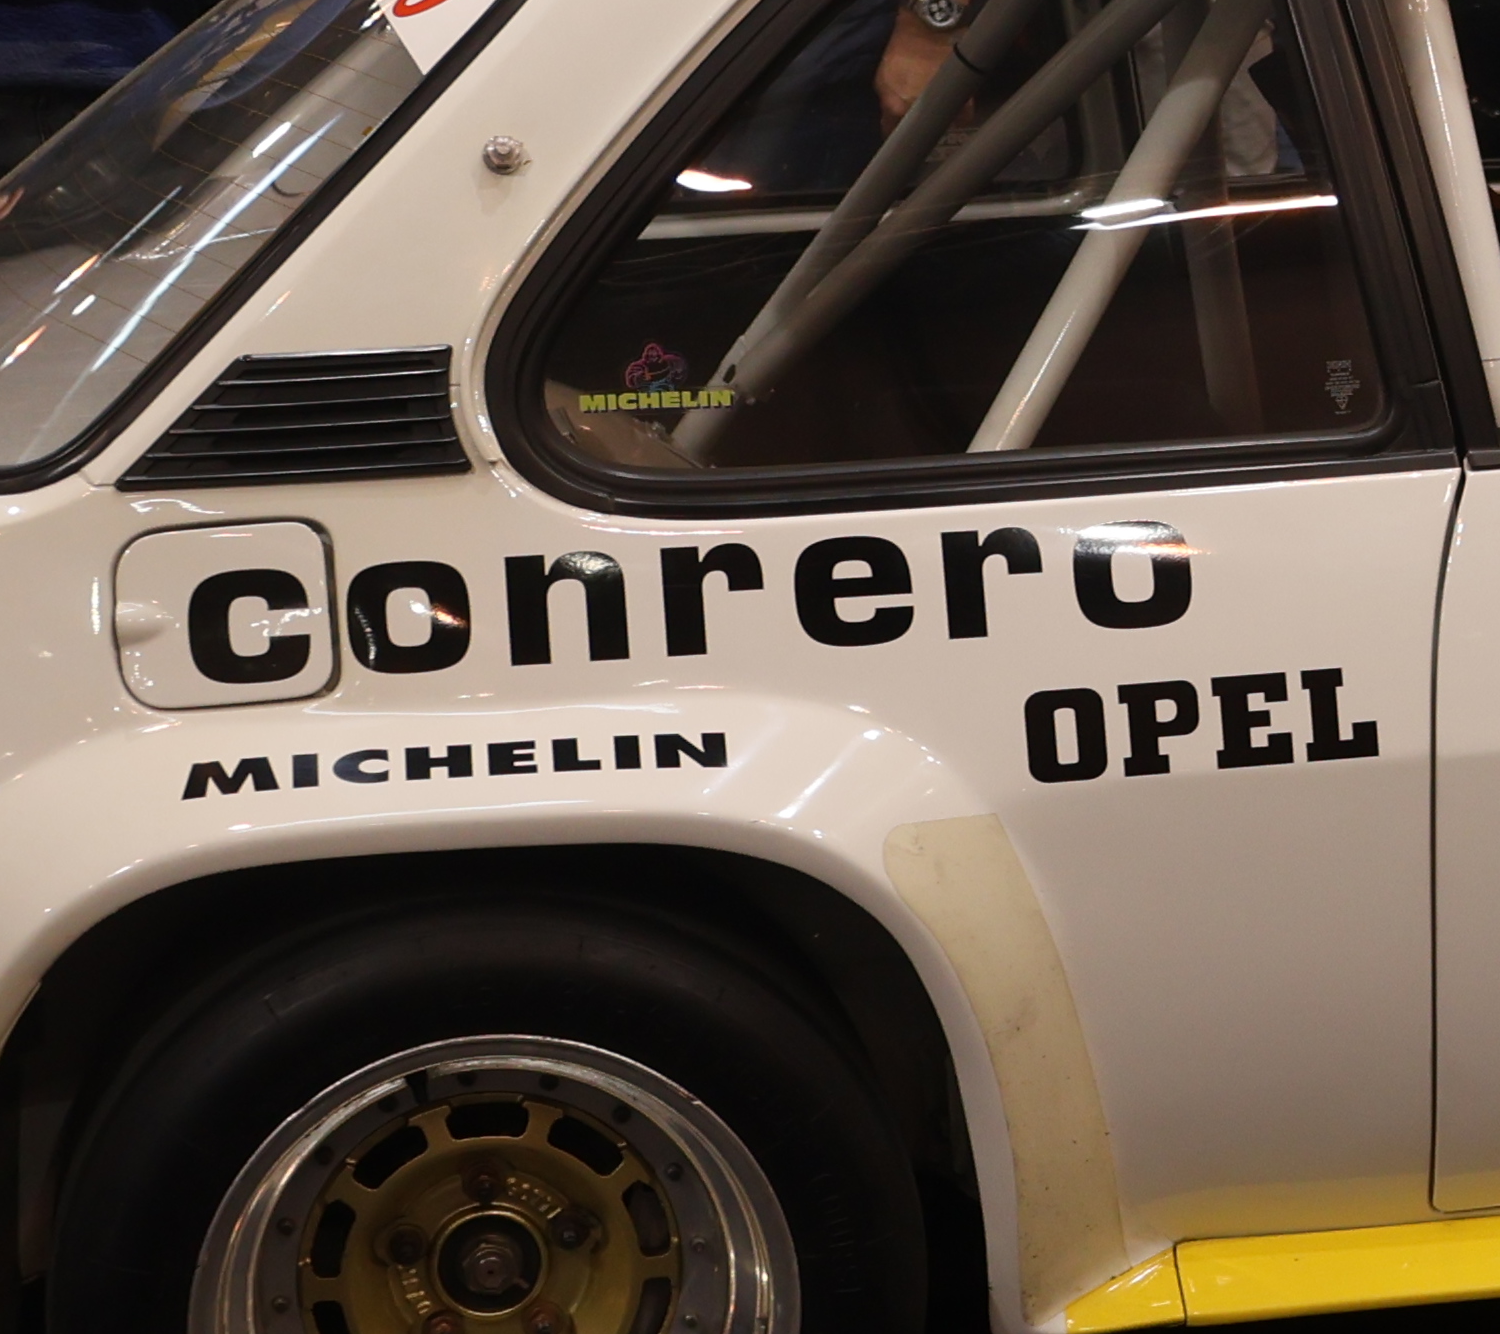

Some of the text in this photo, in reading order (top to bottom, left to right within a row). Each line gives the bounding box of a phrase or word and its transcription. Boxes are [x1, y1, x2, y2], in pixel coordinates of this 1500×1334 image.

[578, 388, 735, 415] MICHELIN
[186, 519, 1195, 686] conrero
[181, 731, 730, 801] MICHELIN
[1024, 667, 1381, 785] OPEL
